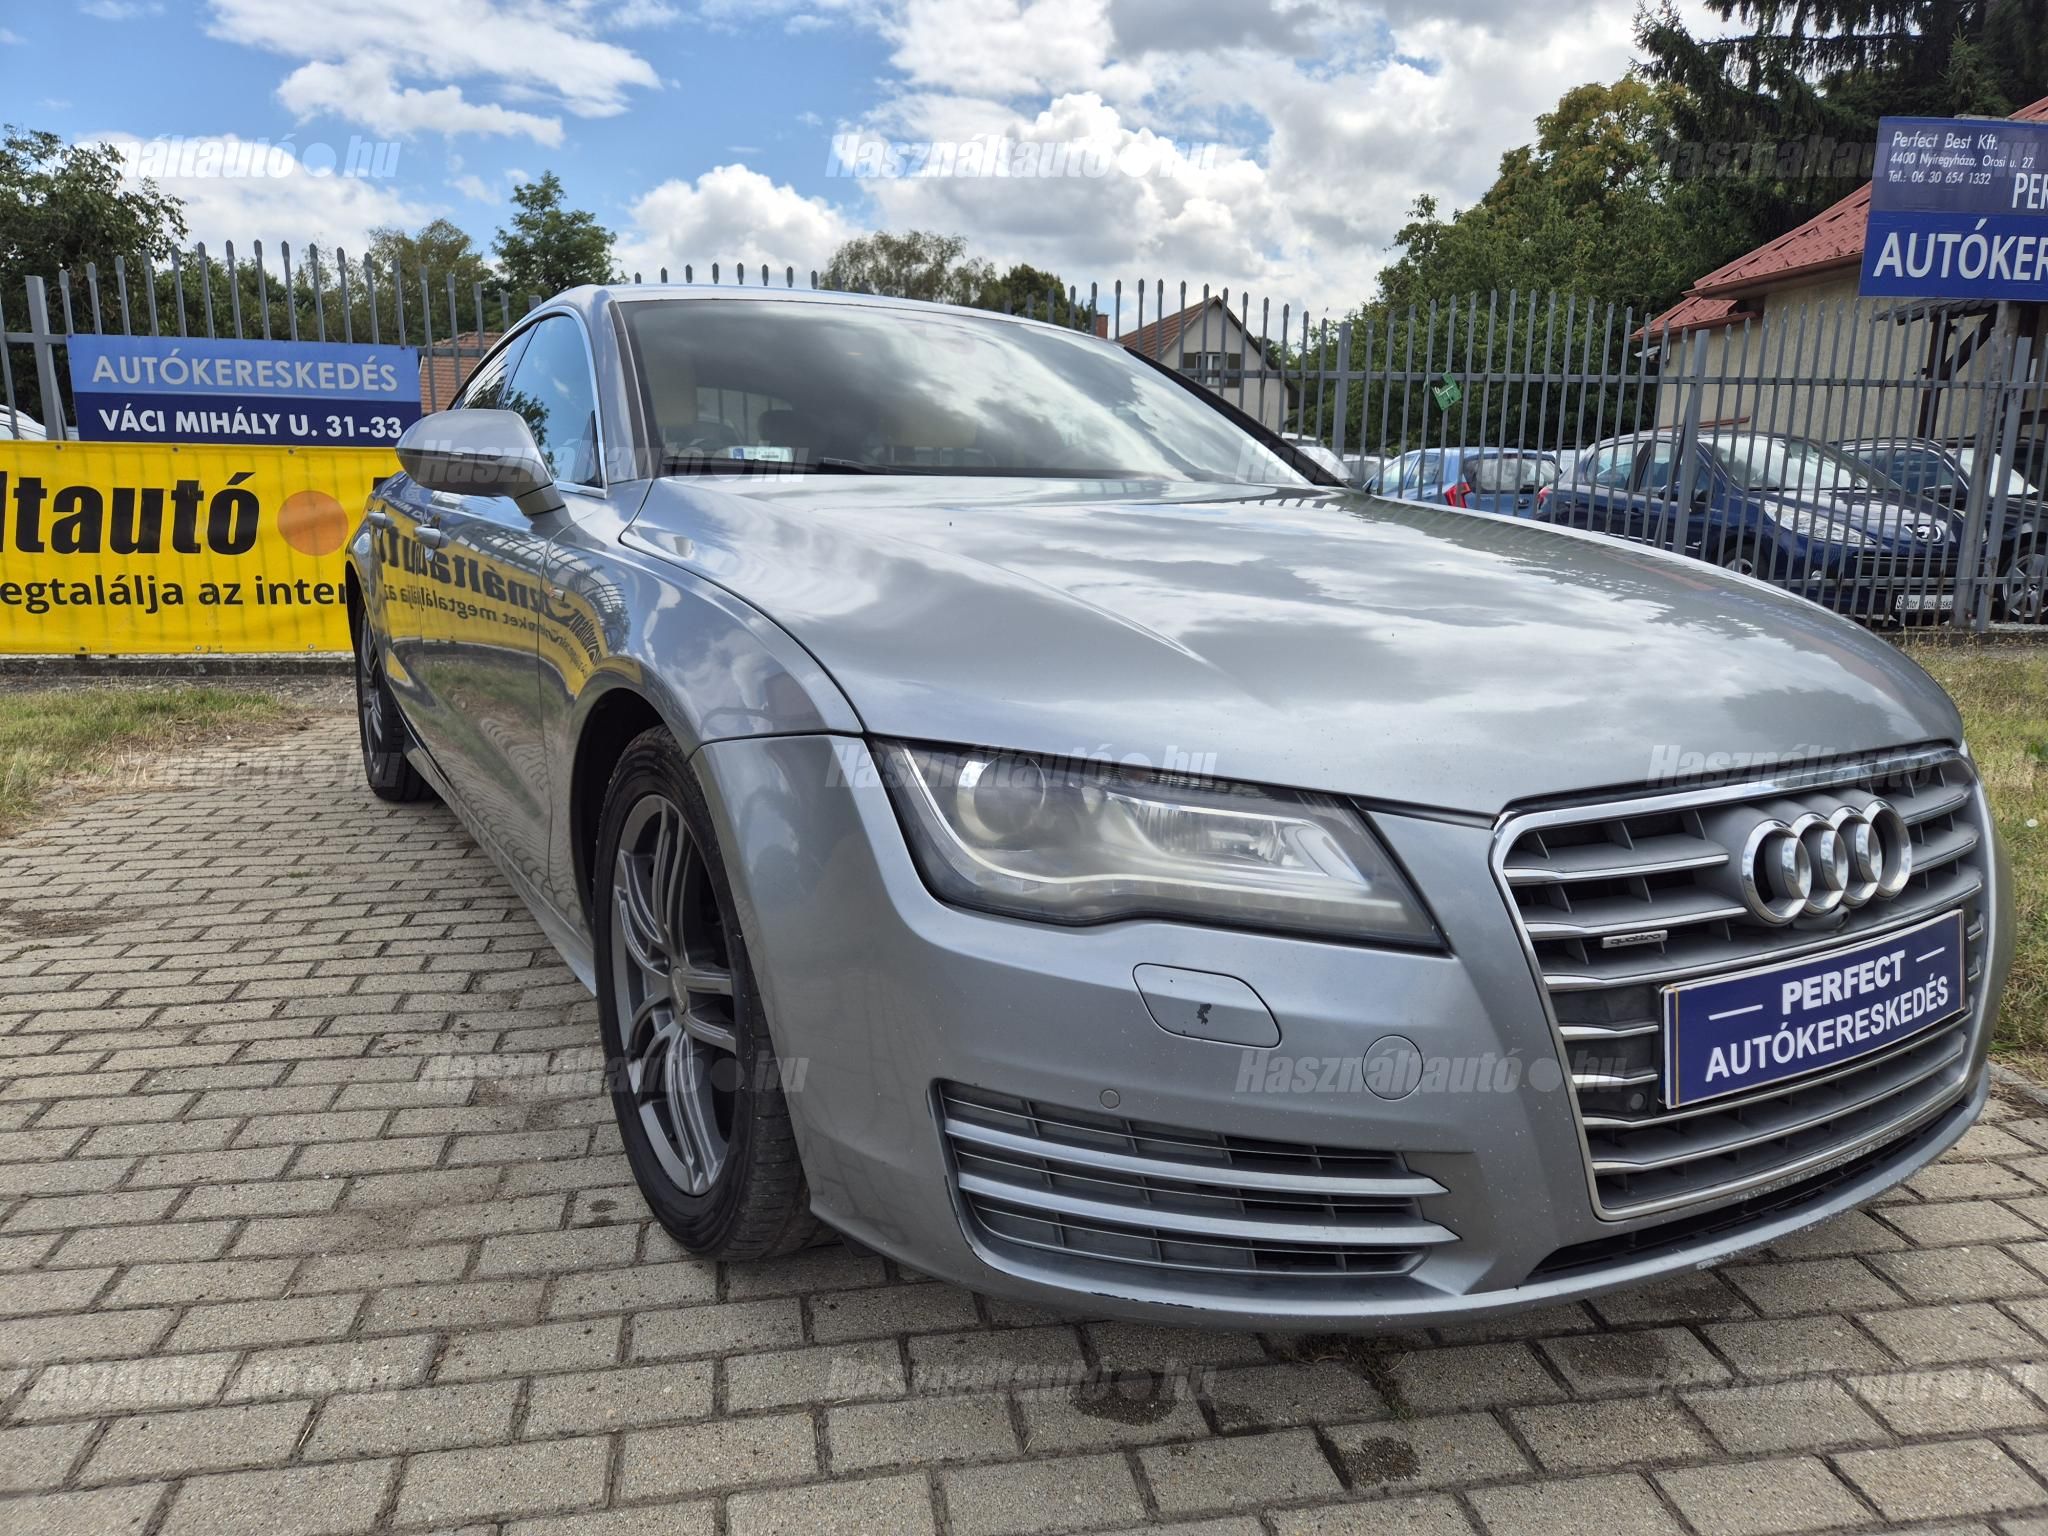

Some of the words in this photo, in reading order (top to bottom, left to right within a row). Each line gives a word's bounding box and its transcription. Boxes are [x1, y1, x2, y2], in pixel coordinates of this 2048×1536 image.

[1892, 131, 1938, 148] Perfect
[1945, 133, 1971, 149] Best
[1977, 134, 1998, 150] Kft.
[1890, 153, 1916, 164] 4400
[1888, 171, 1907, 182] Tel.:
[1911, 171, 1924, 183] 06
[1929, 171, 1941, 183] 30
[1945, 172, 1963, 184] 654
[1968, 172, 1991, 184] 1332
[92, 348, 398, 391] AUTÓKERESKEDÉS
[98, 403, 166, 432] VÁCI
[175, 406, 280, 436] MIHÁLY
[290, 414, 317, 437] U.
[326, 415, 402, 438] 31-33
[0, 471, 260, 556] tautó
[199, 581, 243, 605] az
[1782, 949, 1906, 1016] PERFECT
[1704, 972, 1950, 1083] AUTÓKERESKEDÉS
